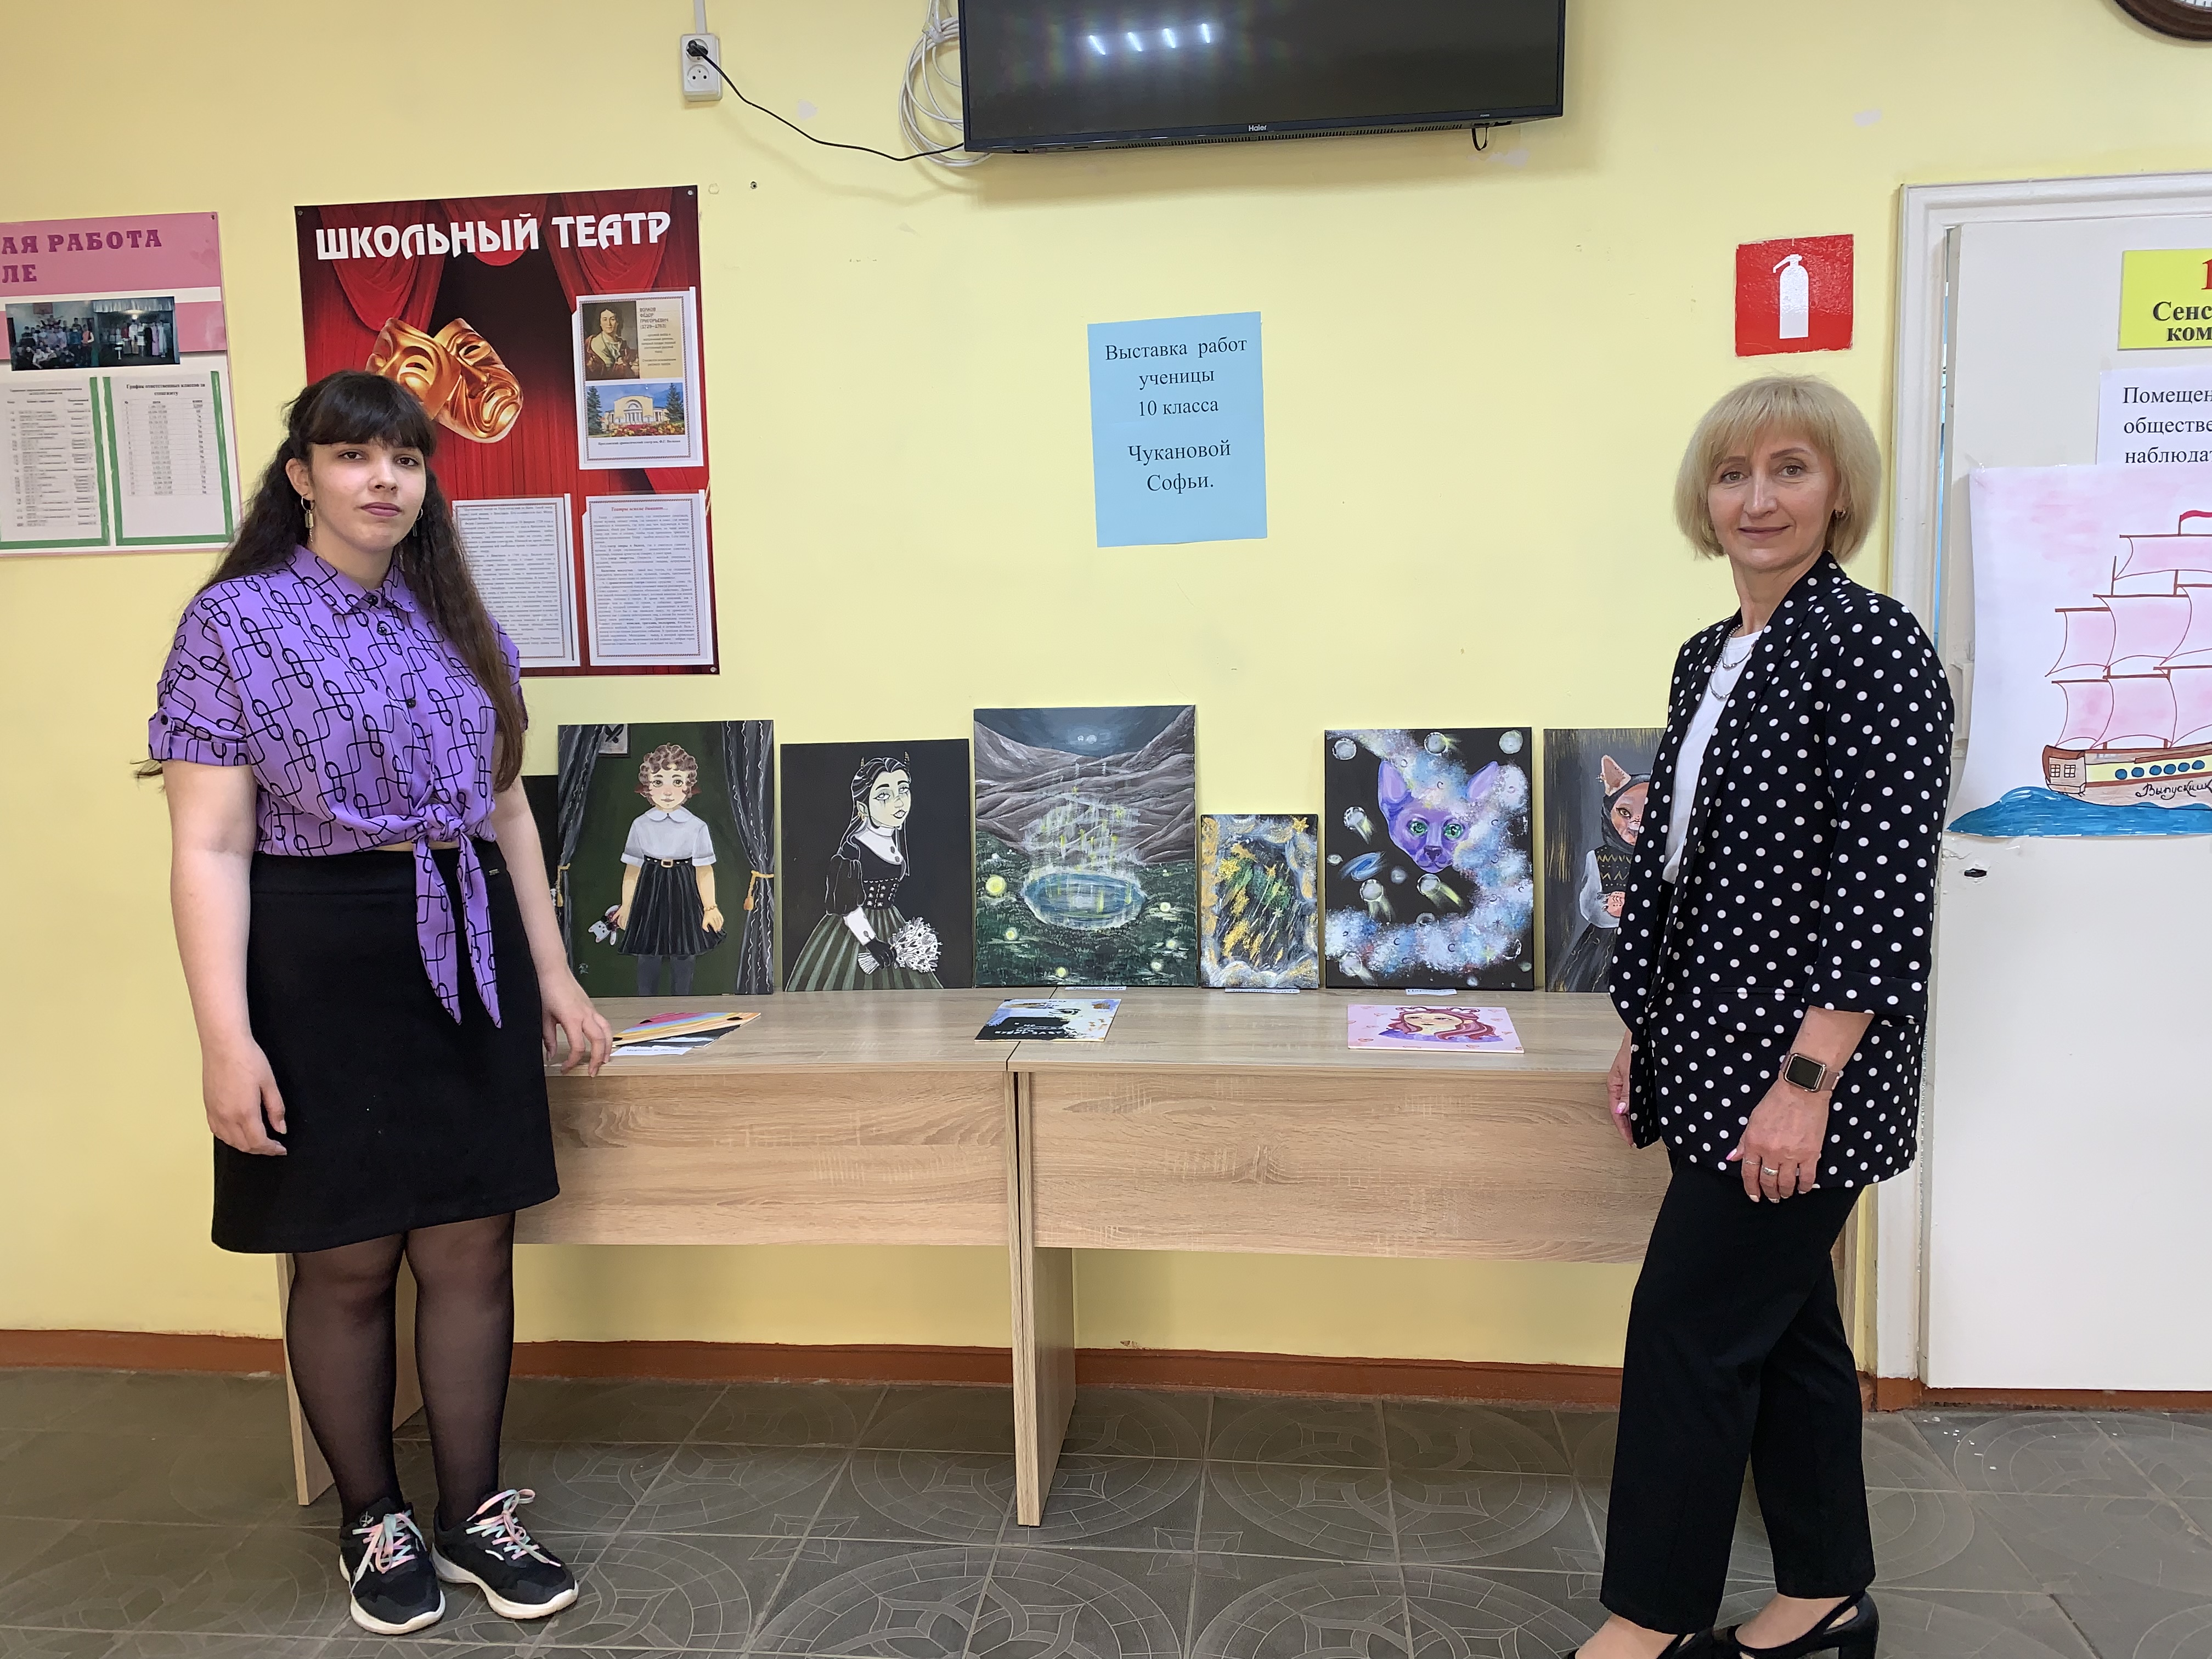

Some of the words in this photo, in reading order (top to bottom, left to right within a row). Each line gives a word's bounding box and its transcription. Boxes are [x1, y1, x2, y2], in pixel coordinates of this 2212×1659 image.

[2, 235, 38, 255] АЯ
[47, 229, 162, 252] РАБОТА
[315, 212, 539, 260] ШКОЛЬНЫЙ
[551, 212, 670, 250] ТЕАТР
[2, 264, 37, 283] ЛЕ
[2152, 301, 2212, 321] Сенс
[2166, 326, 2212, 342] ком
[1105, 342, 1188, 360] Выставка
[1198, 336, 1248, 358] работ
[1138, 370, 1215, 390] ученицы
[2122, 387, 2212, 404] Помещен
[1138, 400, 1157, 416] 10
[1163, 400, 1219, 415] класса
[1127, 439, 1231, 466] Чукановой
[2124, 447, 2212, 464] наблюда
[1147, 473, 1214, 494] Софьи.
